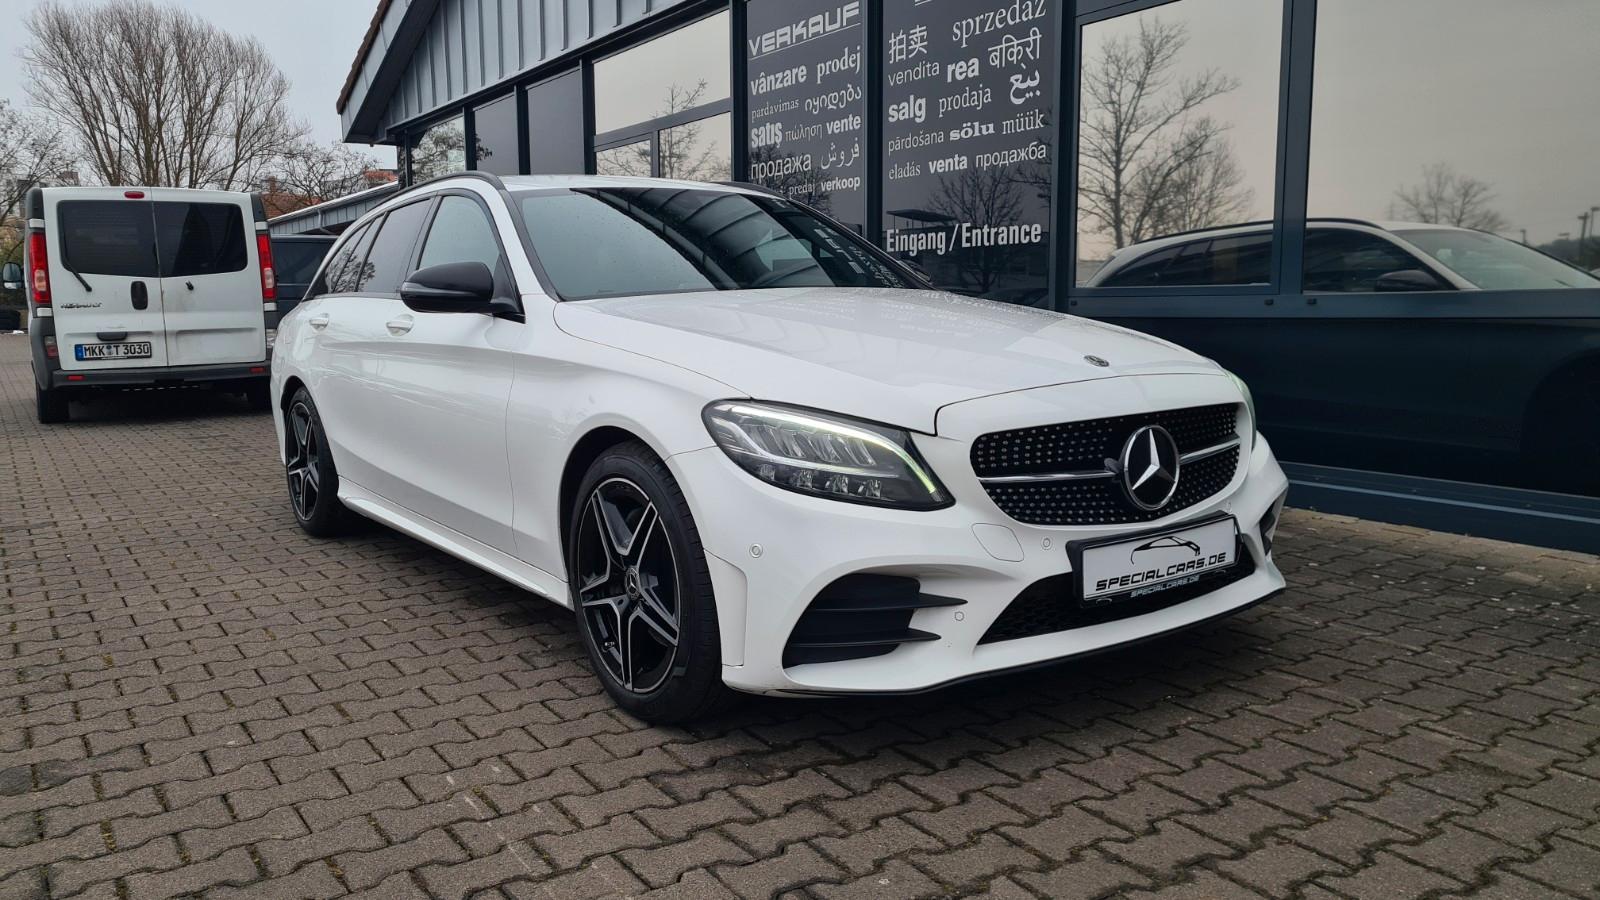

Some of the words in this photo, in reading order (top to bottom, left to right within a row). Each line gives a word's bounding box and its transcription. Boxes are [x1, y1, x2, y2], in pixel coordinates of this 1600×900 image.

[749, 1, 860, 57] VERKAUF
[888, 24, 928, 65] 拍卖
[750, 64, 807, 96] vânzare
[816, 46, 861, 84] prodej
[888, 61, 940, 87] vendita
[946, 57, 979, 83] rea
[804, 83, 862, 115] იყიდება
[1010, 70, 1041, 105] بيع
[751, 99, 799, 123] pardavimas
[888, 95, 926, 123] salg
[939, 84, 992, 117] prodaja
[751, 122, 783, 149] satış
[785, 124, 823, 142] πώληση
[826, 113, 862, 135] vente
[888, 129, 944, 156] pārdošana
[949, 121, 995, 141] sölu
[1002, 109, 1045, 135] müük
[751, 153, 812, 184] продажа
[820, 137, 861, 170] فروش
[888, 162, 921, 180] eladás
[928, 153, 968, 174] venta
[975, 141, 1047, 171] продажба
[789, 179, 816, 200] predaj
[820, 176, 861, 193] verkoop
[84, 345, 105, 357] MKK
[113, 344, 120, 355] T
[123, 344, 149, 355] 3030
[1095, 552, 1227, 592] SPECIALCARS.DE
